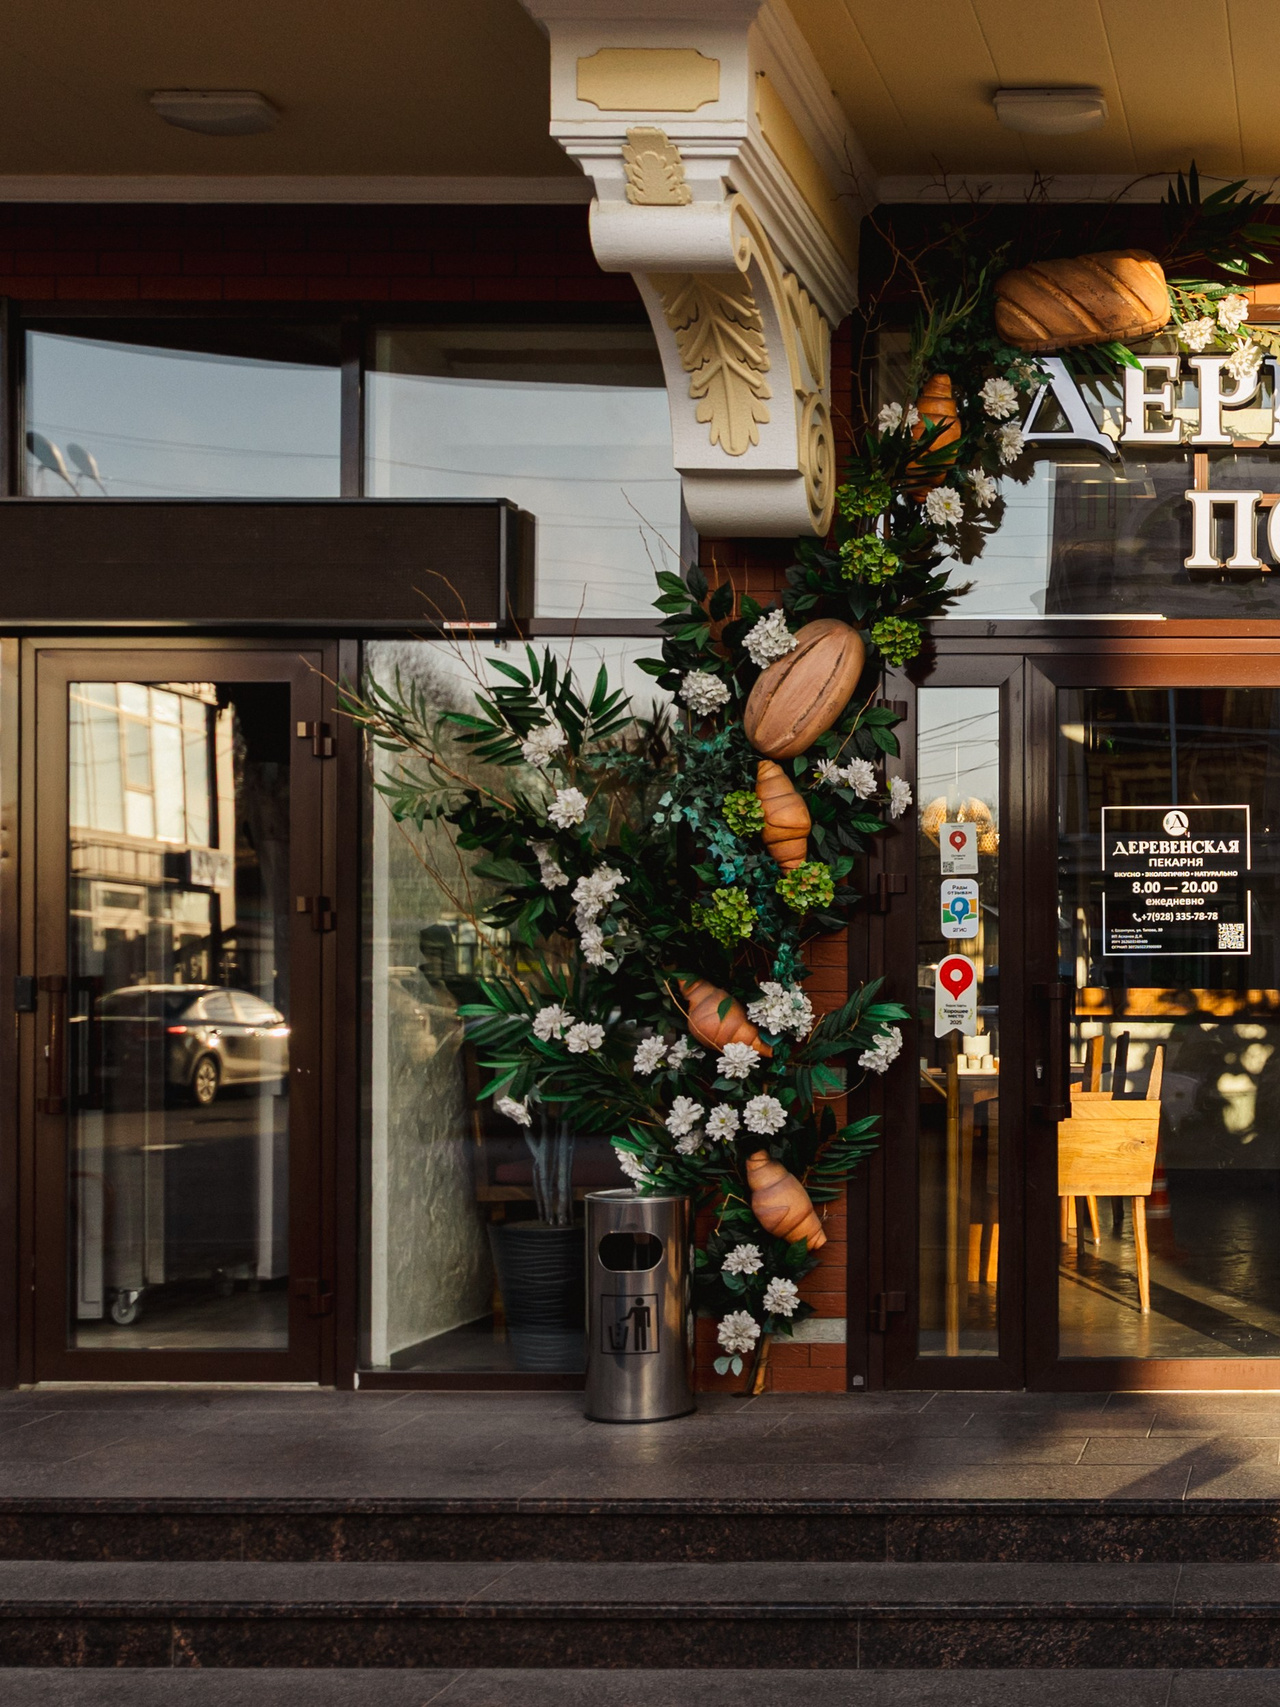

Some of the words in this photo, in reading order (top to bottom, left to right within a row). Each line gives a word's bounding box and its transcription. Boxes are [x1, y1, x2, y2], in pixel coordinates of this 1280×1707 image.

[1112, 840, 1240, 856] ДЕРЕВЕНСКАЯ
[1148, 857, 1204, 868] ПЕКАРНЯ
[1132, 881, 1161, 893] 8.00
[1181, 881, 1218, 893] 20.00
[1145, 897, 1205, 907] ежедневно
[1141, 912, 1174, 922] +7(928)
[1175, 912, 1219, 921] 335-78-78
